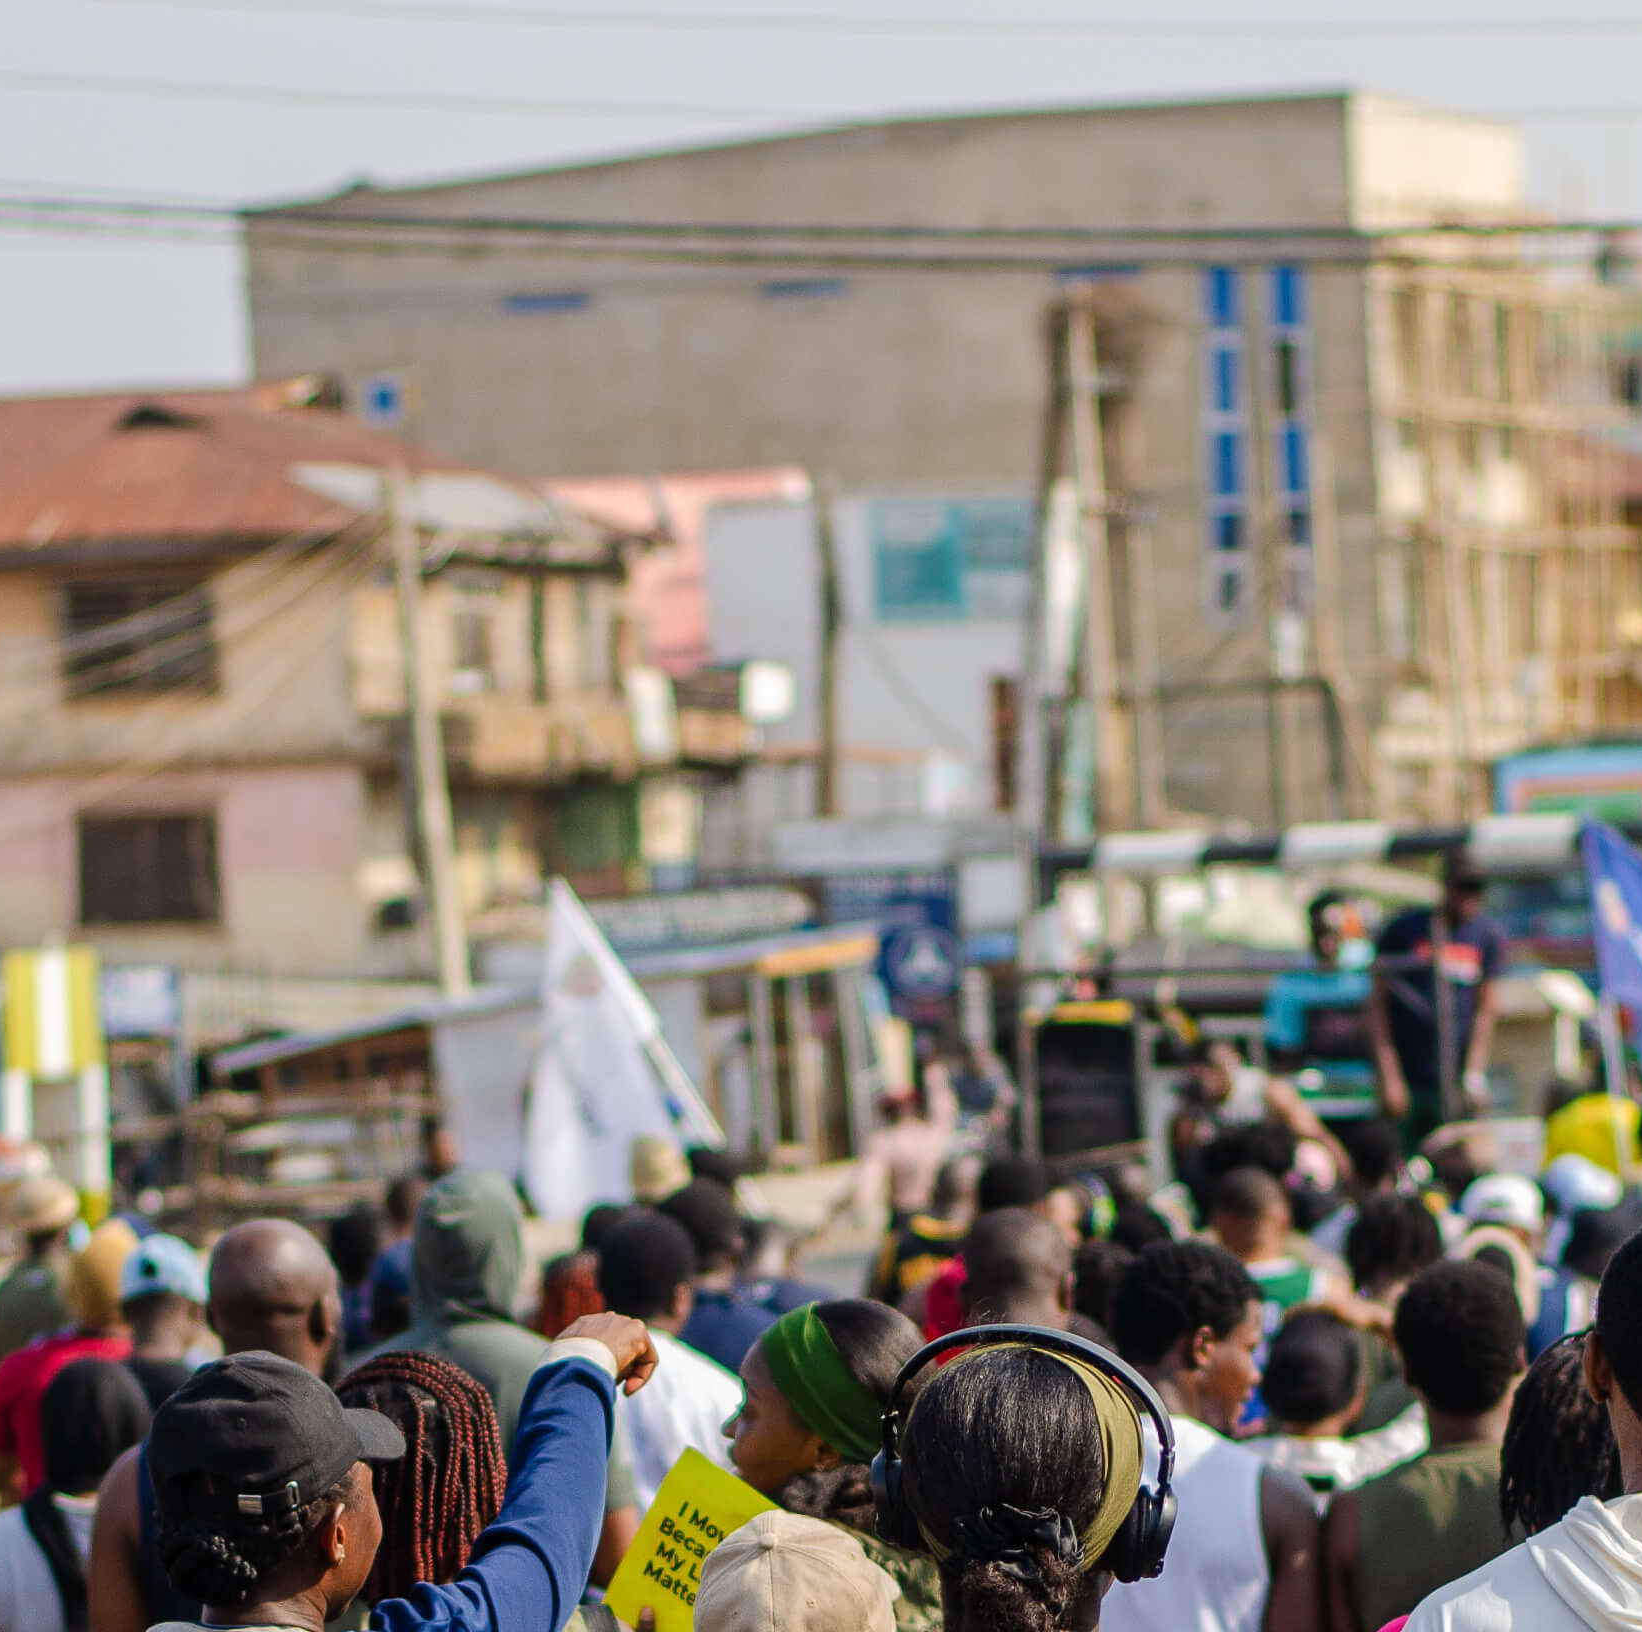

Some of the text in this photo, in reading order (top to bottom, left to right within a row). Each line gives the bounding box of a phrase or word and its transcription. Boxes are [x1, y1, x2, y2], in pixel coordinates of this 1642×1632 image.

[659, 1516, 710, 1559] Beca
[678, 1501, 725, 1543] I Mov
[655, 1541, 685, 1572] My
[643, 1560, 696, 1607] Matte
